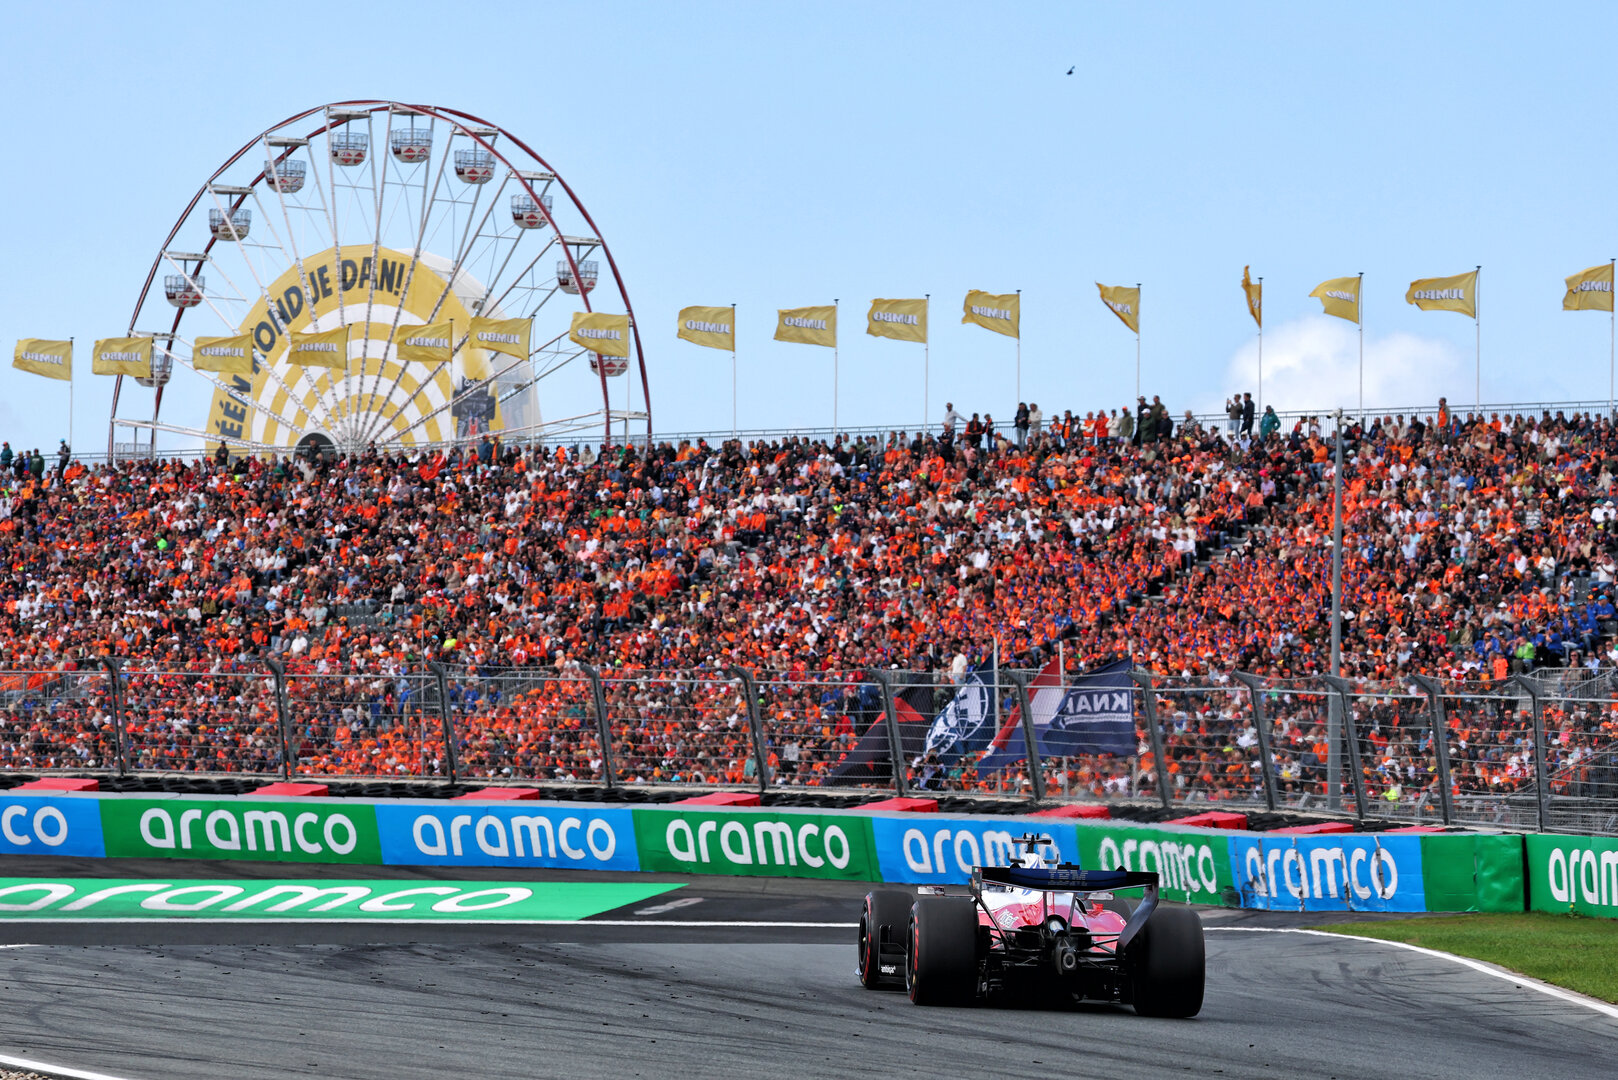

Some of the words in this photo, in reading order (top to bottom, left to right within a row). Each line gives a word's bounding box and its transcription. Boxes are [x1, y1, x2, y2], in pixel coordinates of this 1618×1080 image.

[341, 256, 406, 297] DAN!
[140, 808, 357, 855] aramco
[412, 814, 616, 861] aramco
[666, 819, 850, 869] aramco
[1100, 837, 1217, 894] aramco
[1246, 846, 1398, 900] aramco
[0, 883, 533, 912] aramco
